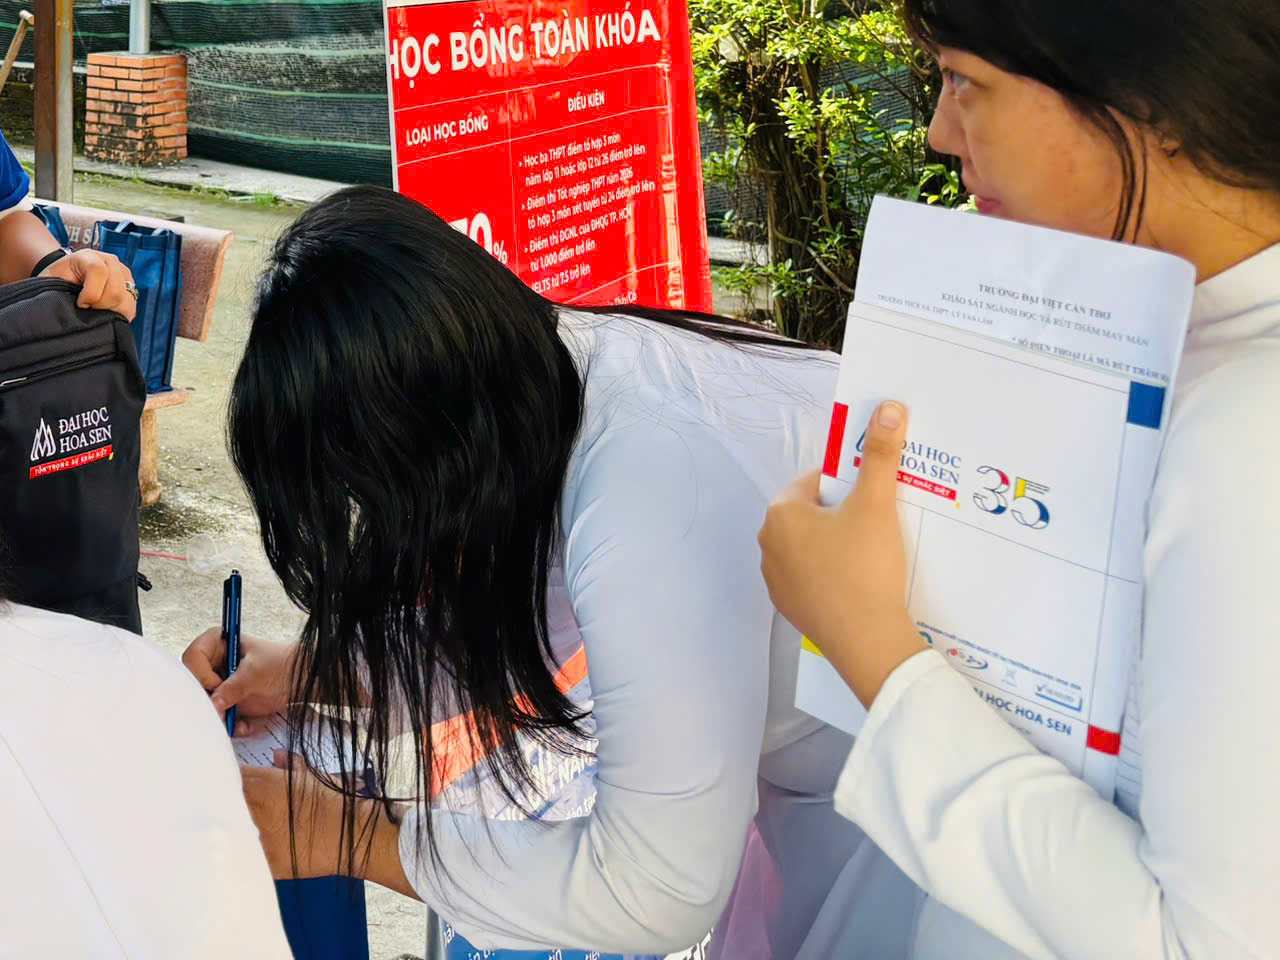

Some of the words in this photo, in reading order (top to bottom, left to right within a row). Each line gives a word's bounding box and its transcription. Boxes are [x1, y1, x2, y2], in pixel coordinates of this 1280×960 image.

[388, 33, 441, 89] HỌC
[449, 13, 524, 71] BỔNG
[531, 9, 589, 58] TOÀN
[595, 2, 661, 49] KHÓA
[406, 126, 431, 147] LOẠI
[434, 121, 456, 143] HỌC
[459, 112, 489, 136] BỔNG
[59, 414, 81, 434] ĐẠI
[81, 407, 109, 428] HỌC
[60, 432, 88, 453] HOA
[89, 425, 112, 445] SEN
[931, 464, 960, 484] SEN
[973, 465, 1050, 530] 35
[1015, 705, 1043, 725] HOA
[1046, 718, 1072, 736] SEN
